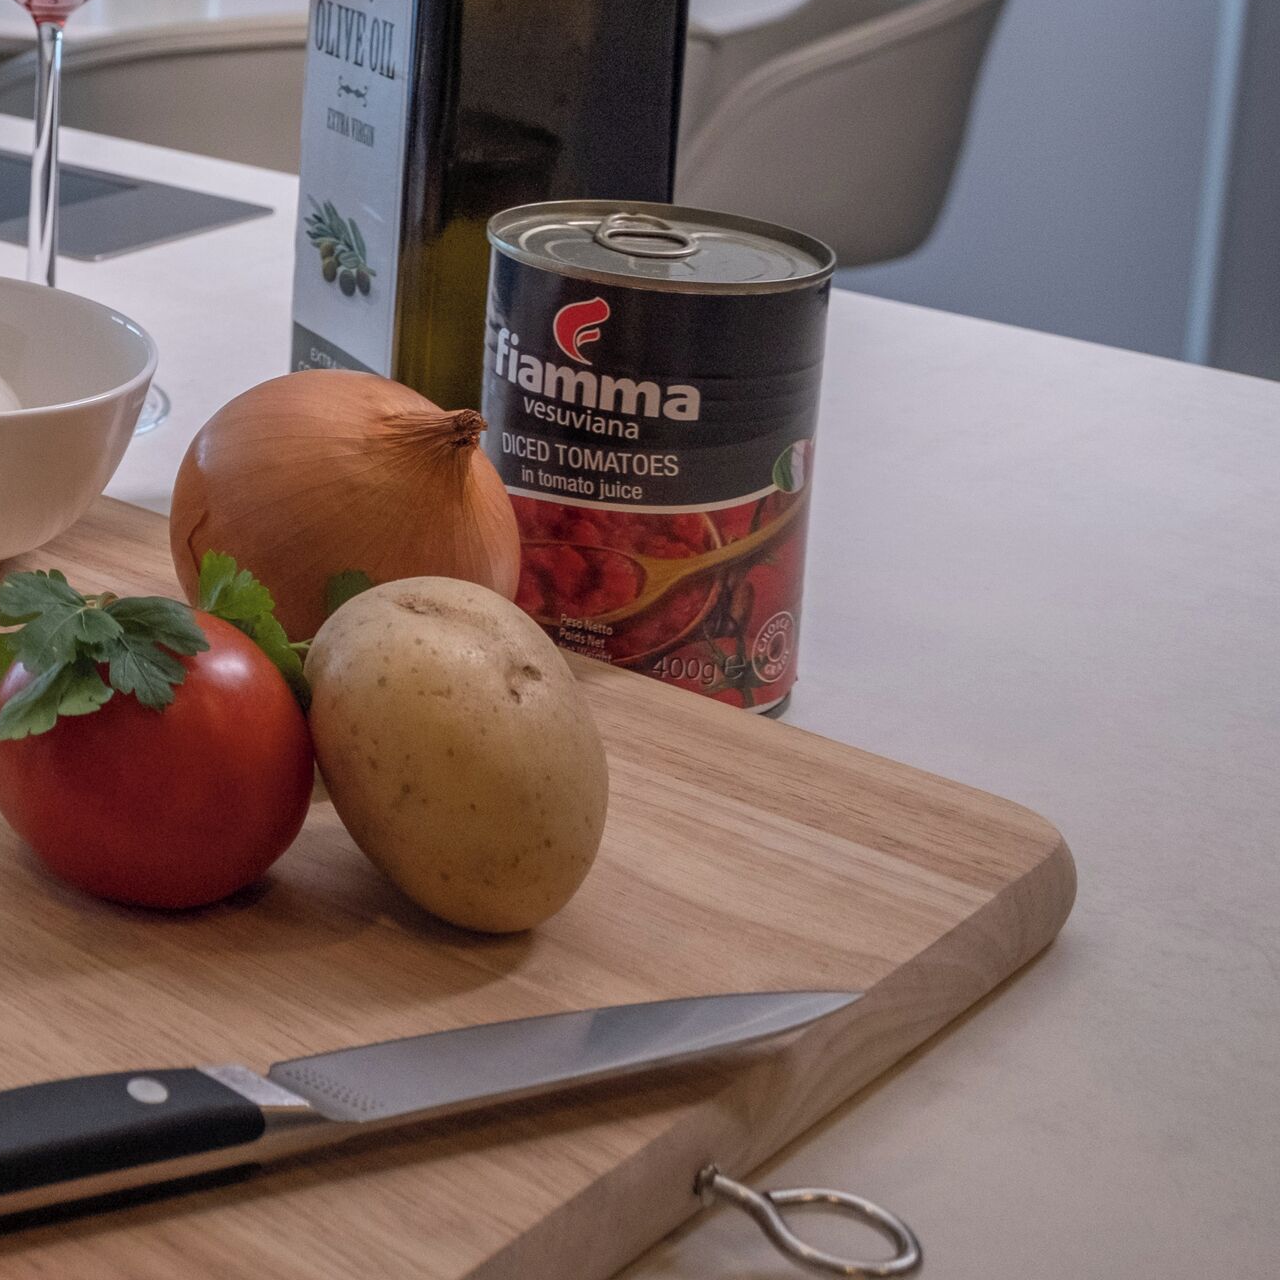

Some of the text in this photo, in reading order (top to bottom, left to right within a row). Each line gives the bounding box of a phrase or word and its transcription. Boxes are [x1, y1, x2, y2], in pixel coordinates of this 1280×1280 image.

[369, 17, 396, 80] OIL
[327, 107, 375, 148] EXTRA VIRGIN
[495, 327, 701, 421] fiamma
[524, 396, 639, 440] vesuviana
[502, 432, 679, 477] DICED TOMATOES
[521, 466, 643, 500] in tomato juice
[559, 627, 585, 644] Poids
[586, 634, 605, 649] Net
[560, 613, 614, 636] Peso Netto
[651, 656, 717, 688] 400g
